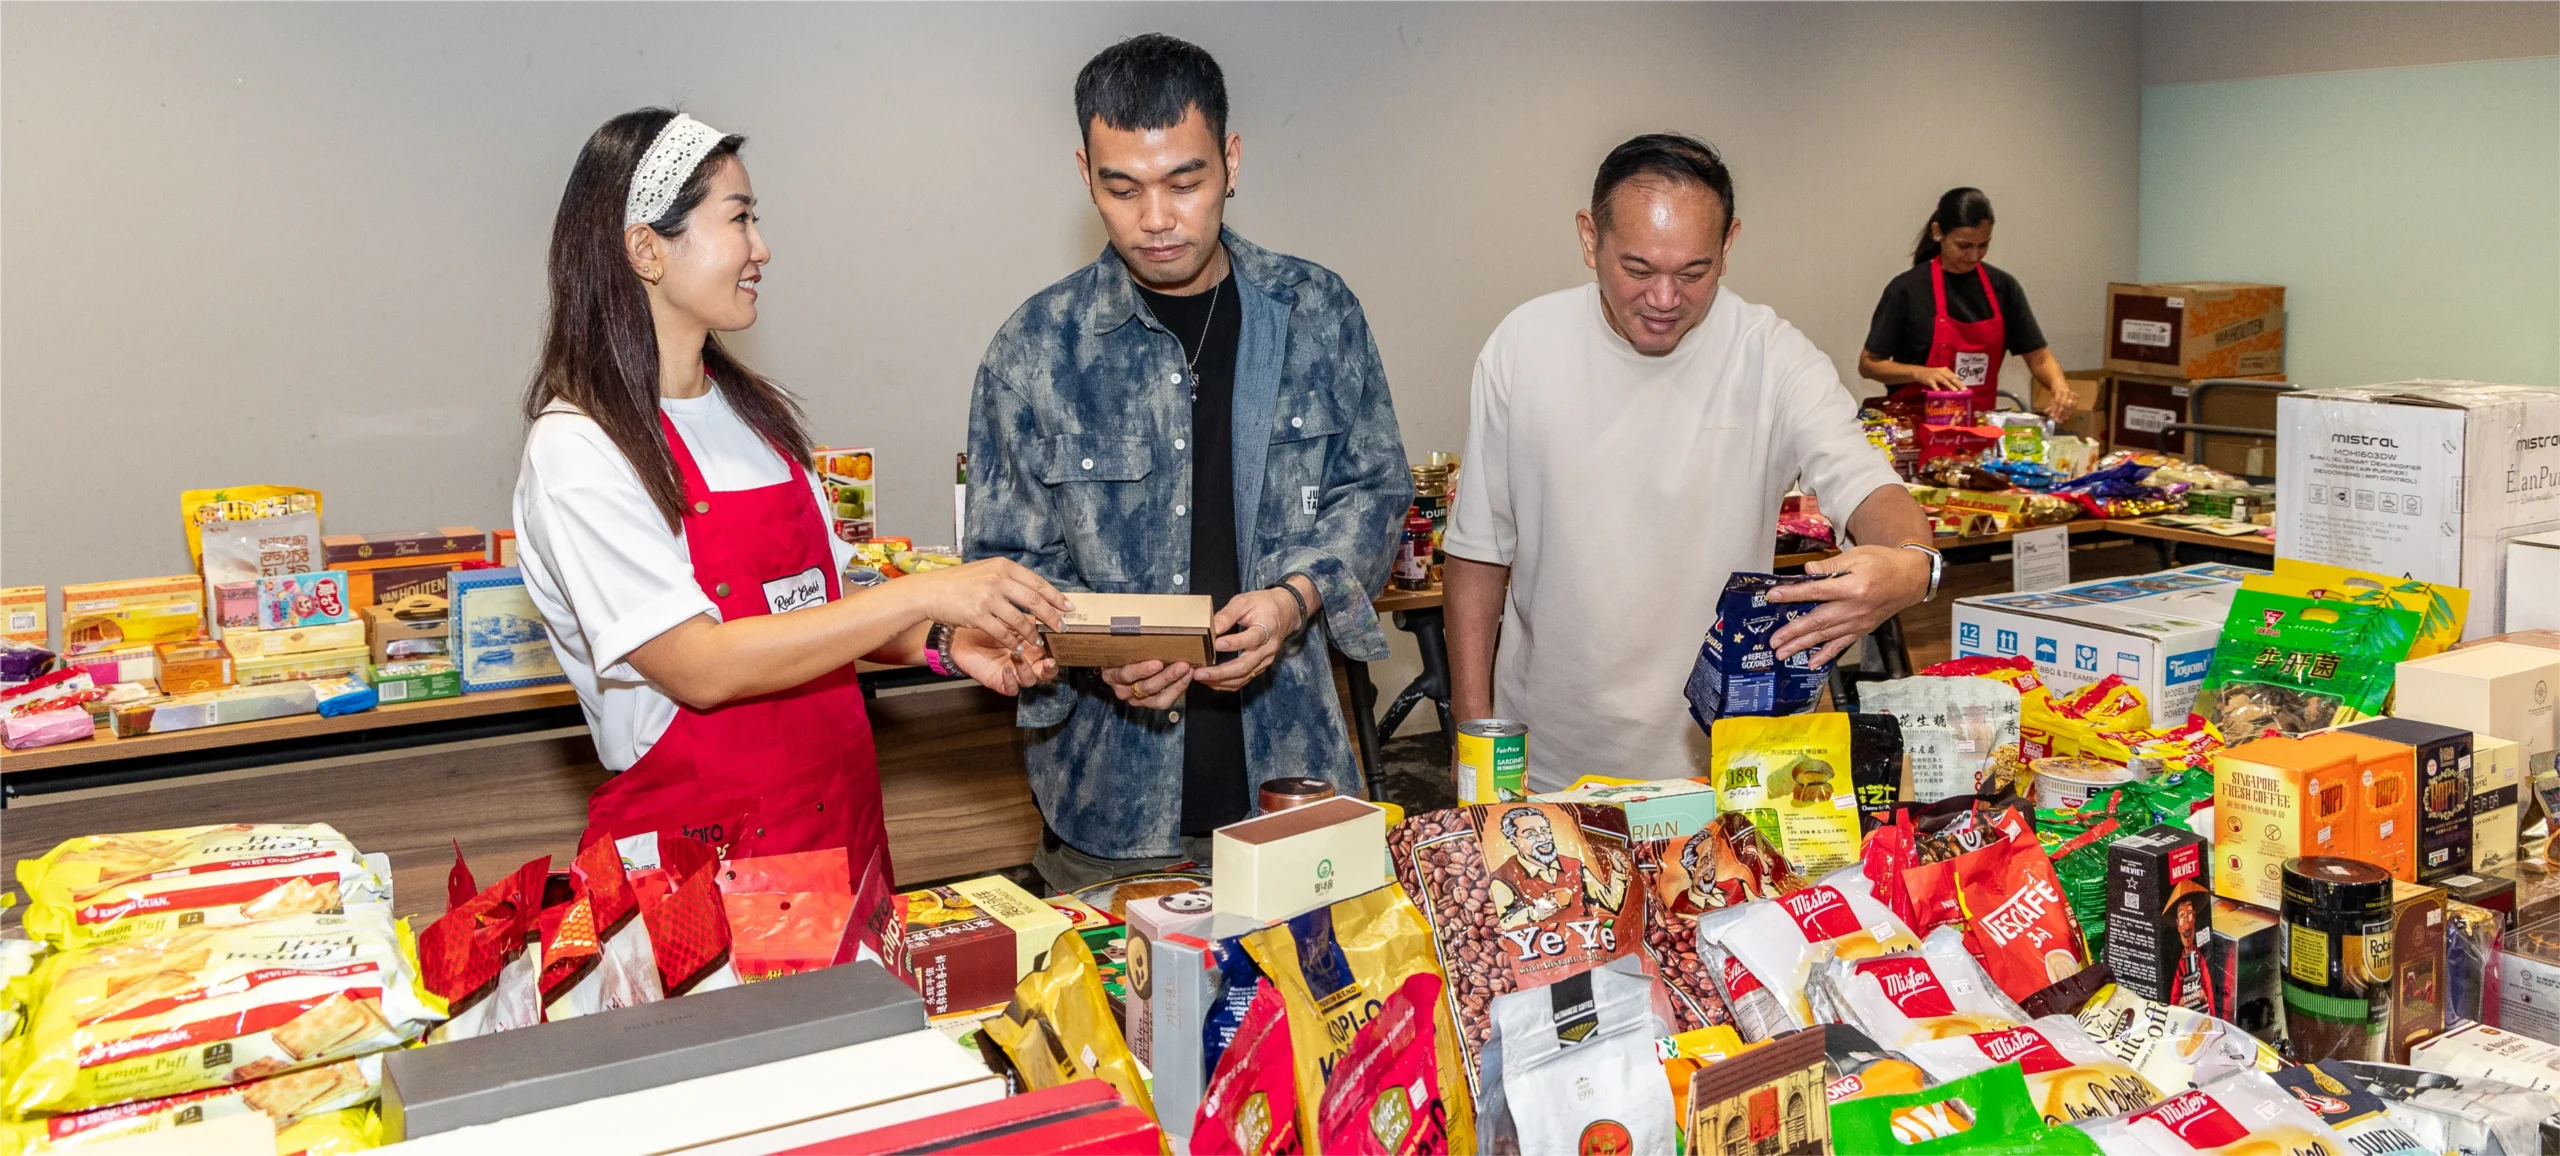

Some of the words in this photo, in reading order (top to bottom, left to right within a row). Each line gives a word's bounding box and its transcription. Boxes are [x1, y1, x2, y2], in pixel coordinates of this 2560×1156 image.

[2331, 433, 2399, 448] mistral
[2333, 449, 2398, 461] MDH1603DW
[380, 591, 399, 604] VAN
[401, 577, 446, 599] HOUTEN
[774, 590, 797, 612] Red
[1961, 625, 1978, 638] 12
[1741, 659, 1774, 669] GOODNESS
[2039, 665, 2056, 676] BBQ
[2056, 669, 2062, 678] &
[2169, 658, 2208, 678] Toyomi
[2256, 648, 2342, 680] 牛肝菌
[1899, 713, 1948, 728] 花生糖
[1496, 746, 1520, 754] FairPrice
[1496, 756, 1525, 766] SARDINES
[2231, 771, 2280, 793] SINGAPORE
[2221, 783, 2251, 802] FRESH
[2253, 788, 2291, 809] COFFEE
[2119, 865, 2146, 877] MR.VIET
[1786, 888, 1839, 917] Mister
[138, 917, 168, 932] Puff
[1505, 922, 1567, 962] Yé
[1566, 918, 1618, 953] Yé
[1882, 966, 1932, 997] Mister
[1578, 1000, 1594, 1013] COFFEE
[1983, 1030, 2039, 1062] Mister
[93, 1063, 149, 1082] Lemon
[155, 1053, 189, 1072] Puff
[2155, 1091, 2209, 1126] Mister
